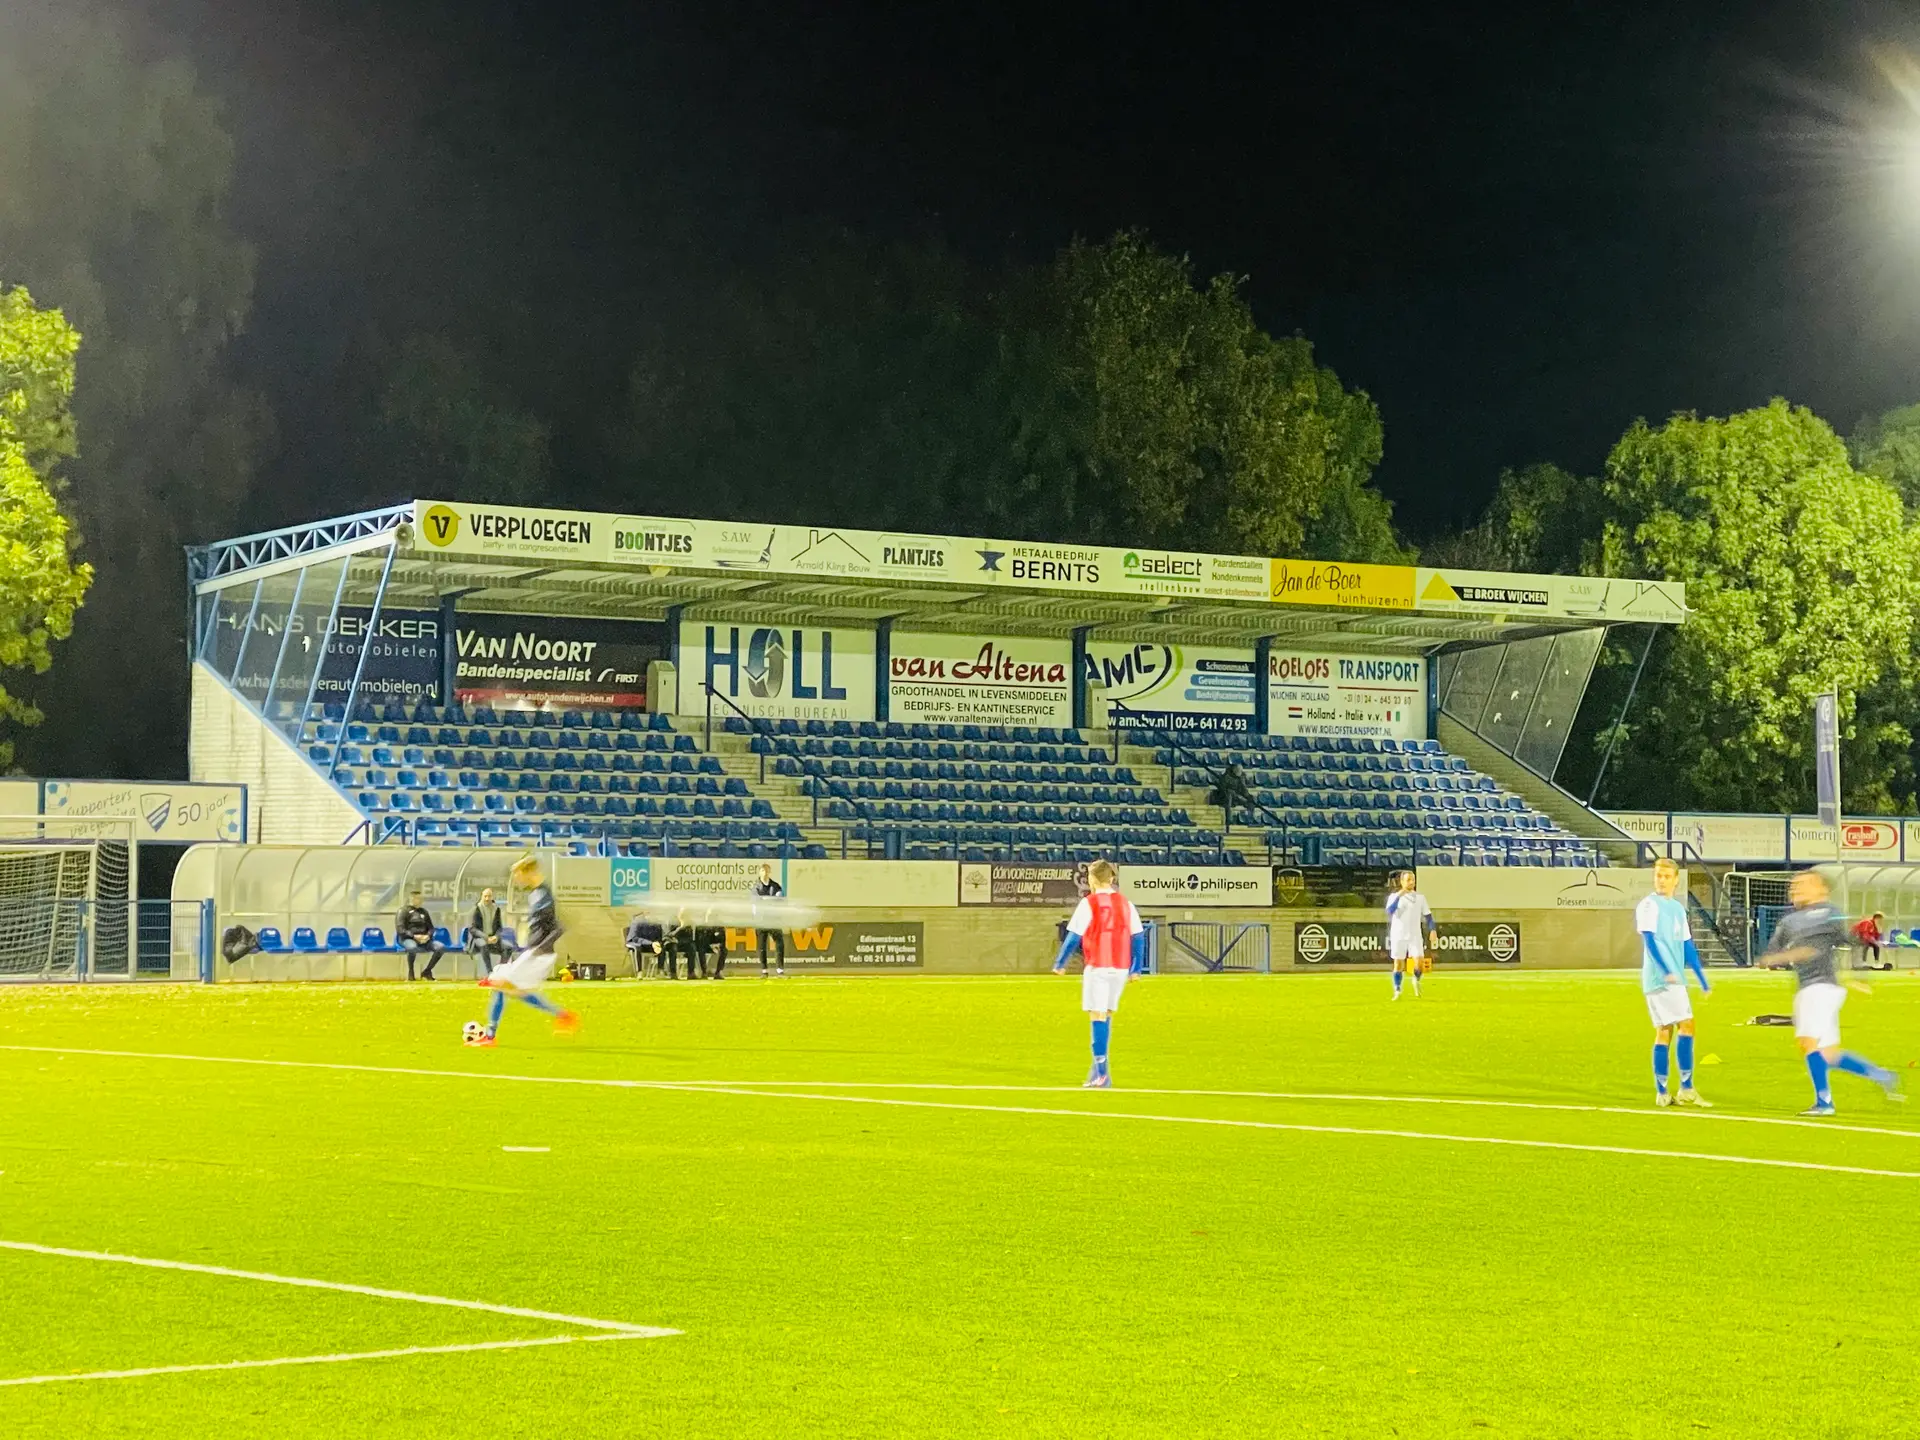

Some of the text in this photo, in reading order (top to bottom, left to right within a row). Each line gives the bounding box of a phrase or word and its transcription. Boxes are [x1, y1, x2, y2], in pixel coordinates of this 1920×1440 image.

[470, 513, 591, 544] VERPLOEGEN
[615, 531, 692, 553] BOONTJES
[883, 547, 944, 567] PLANTJES
[1013, 548, 1100, 562] METAALBEDRIJF
[796, 560, 824, 570] Arnold
[849, 563, 871, 573] Bouw
[1012, 560, 1100, 583] BERNTS
[1142, 555, 1202, 576] select
[1213, 558, 1263, 570] Paardenstallen
[1212, 572, 1263, 583] Hondenkennels
[1273, 565, 1361, 597] Jan de Boer
[1337, 593, 1415, 607] tuinhuizen.nl
[1474, 588, 1506, 601] BROEK
[1507, 591, 1548, 604] WIJCHEN
[216, 612, 438, 640] HANS DEKKER
[455, 630, 598, 662] VAN NOORT
[891, 642, 1068, 684] van Altena
[1270, 656, 1420, 682] ROELOFS TRANSPORT
[456, 662, 592, 682] Bandenspecialist
[891, 686, 1067, 702] GROOTHANDEL IN LEVENSMIDDELEN
[1301, 692, 1330, 702] HOLLAND
[794, 706, 849, 719] BUREAU
[904, 701, 1056, 716] BEDRIJFS- EN KANTINESERVICE
[1307, 708, 1336, 720] Holland
[1200, 718, 1218, 729] 641
[1220, 719, 1233, 729] 42
[1235, 720, 1247, 730] 93
[177, 793, 229, 827] 50 jaar
[1611, 818, 1666, 834] kenburg
[677, 862, 745, 875] accountants
[613, 869, 650, 888] OBC
[665, 876, 757, 894] belastingadvise
[1133, 878, 1258, 892] stolwijk philipsen
[1557, 897, 1587, 906] Driessen
[1333, 936, 1382, 951] LUNCH.
